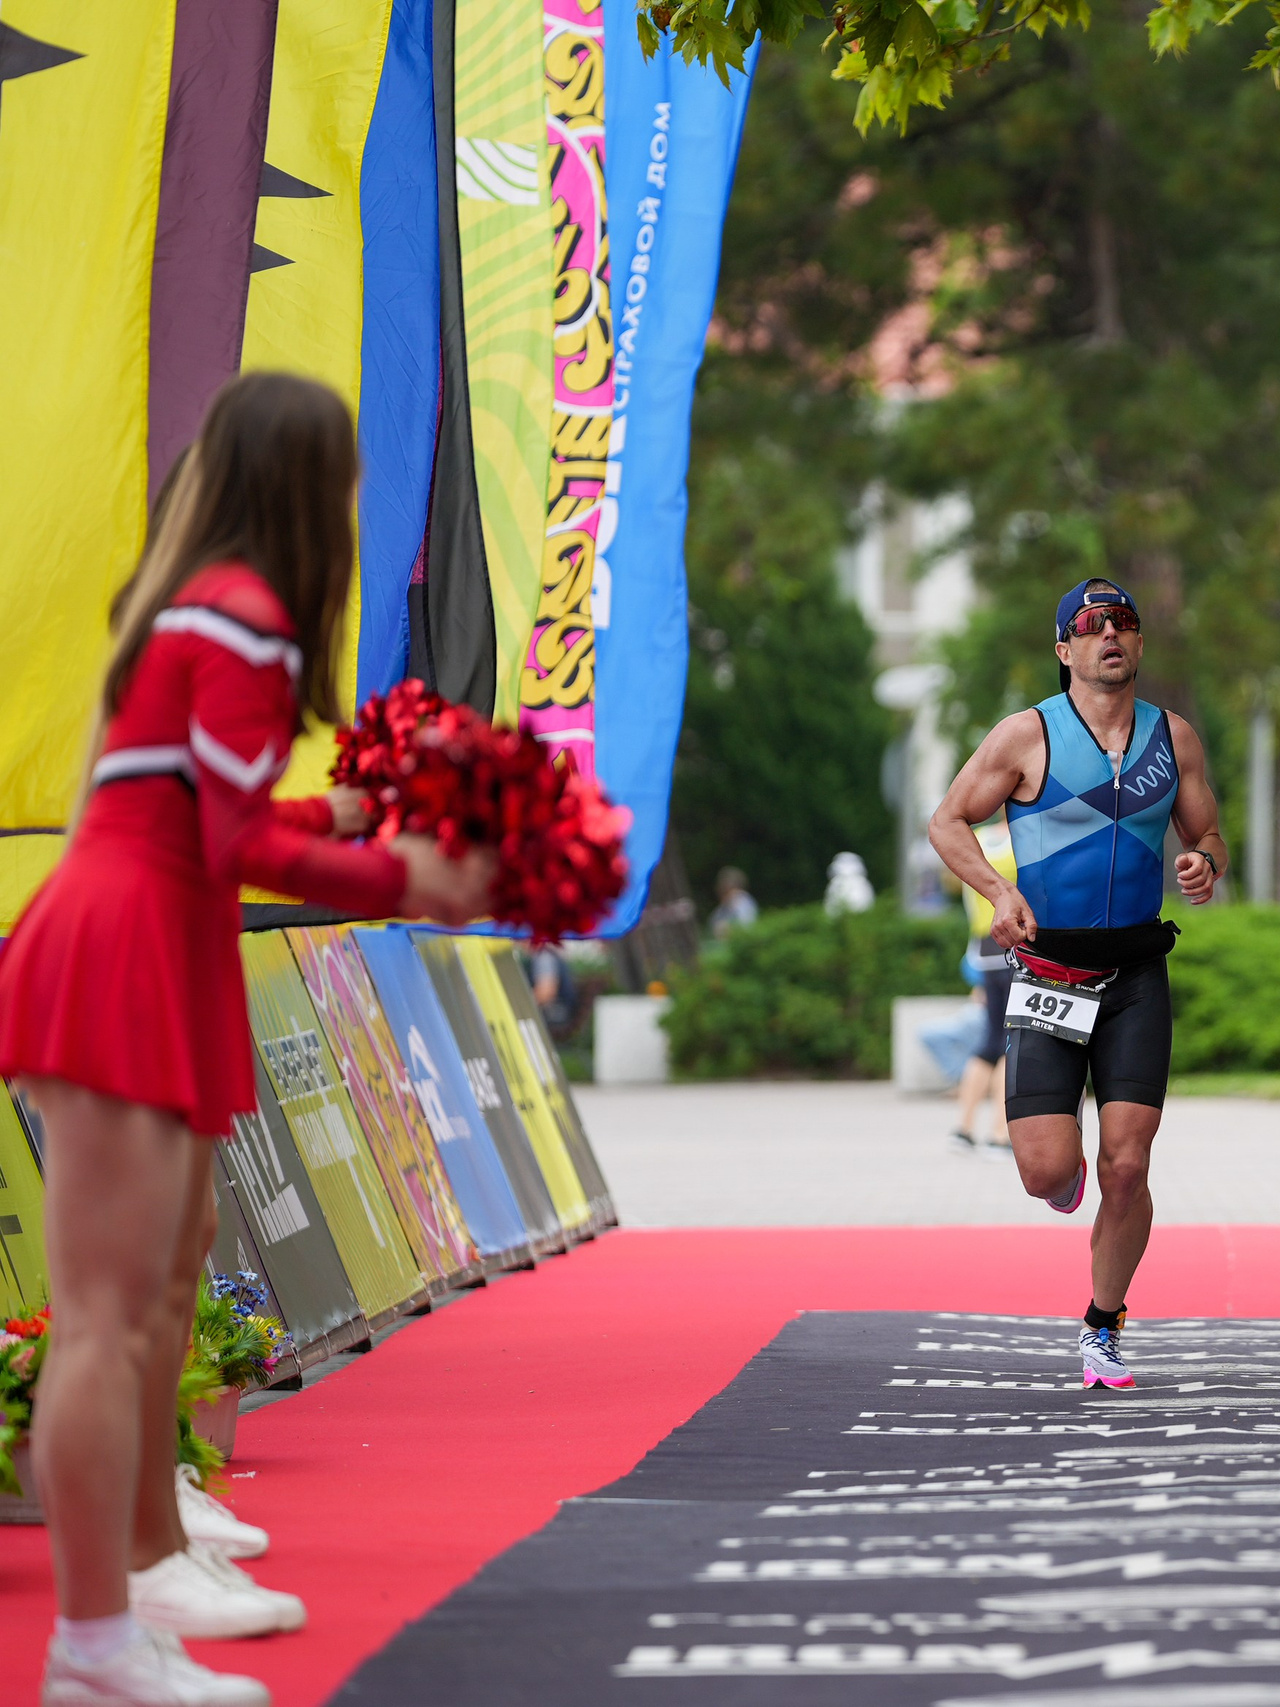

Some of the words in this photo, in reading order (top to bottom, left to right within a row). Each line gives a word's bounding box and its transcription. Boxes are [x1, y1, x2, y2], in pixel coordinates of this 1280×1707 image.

[613, 196, 661, 411] СТРАХОВОЙ
[647, 102, 671, 190] ДОМ
[1025, 992, 1074, 1021] 497
[1031, 1020, 1054, 1031] ARTEM
[851, 1424, 1111, 1434] IRON
